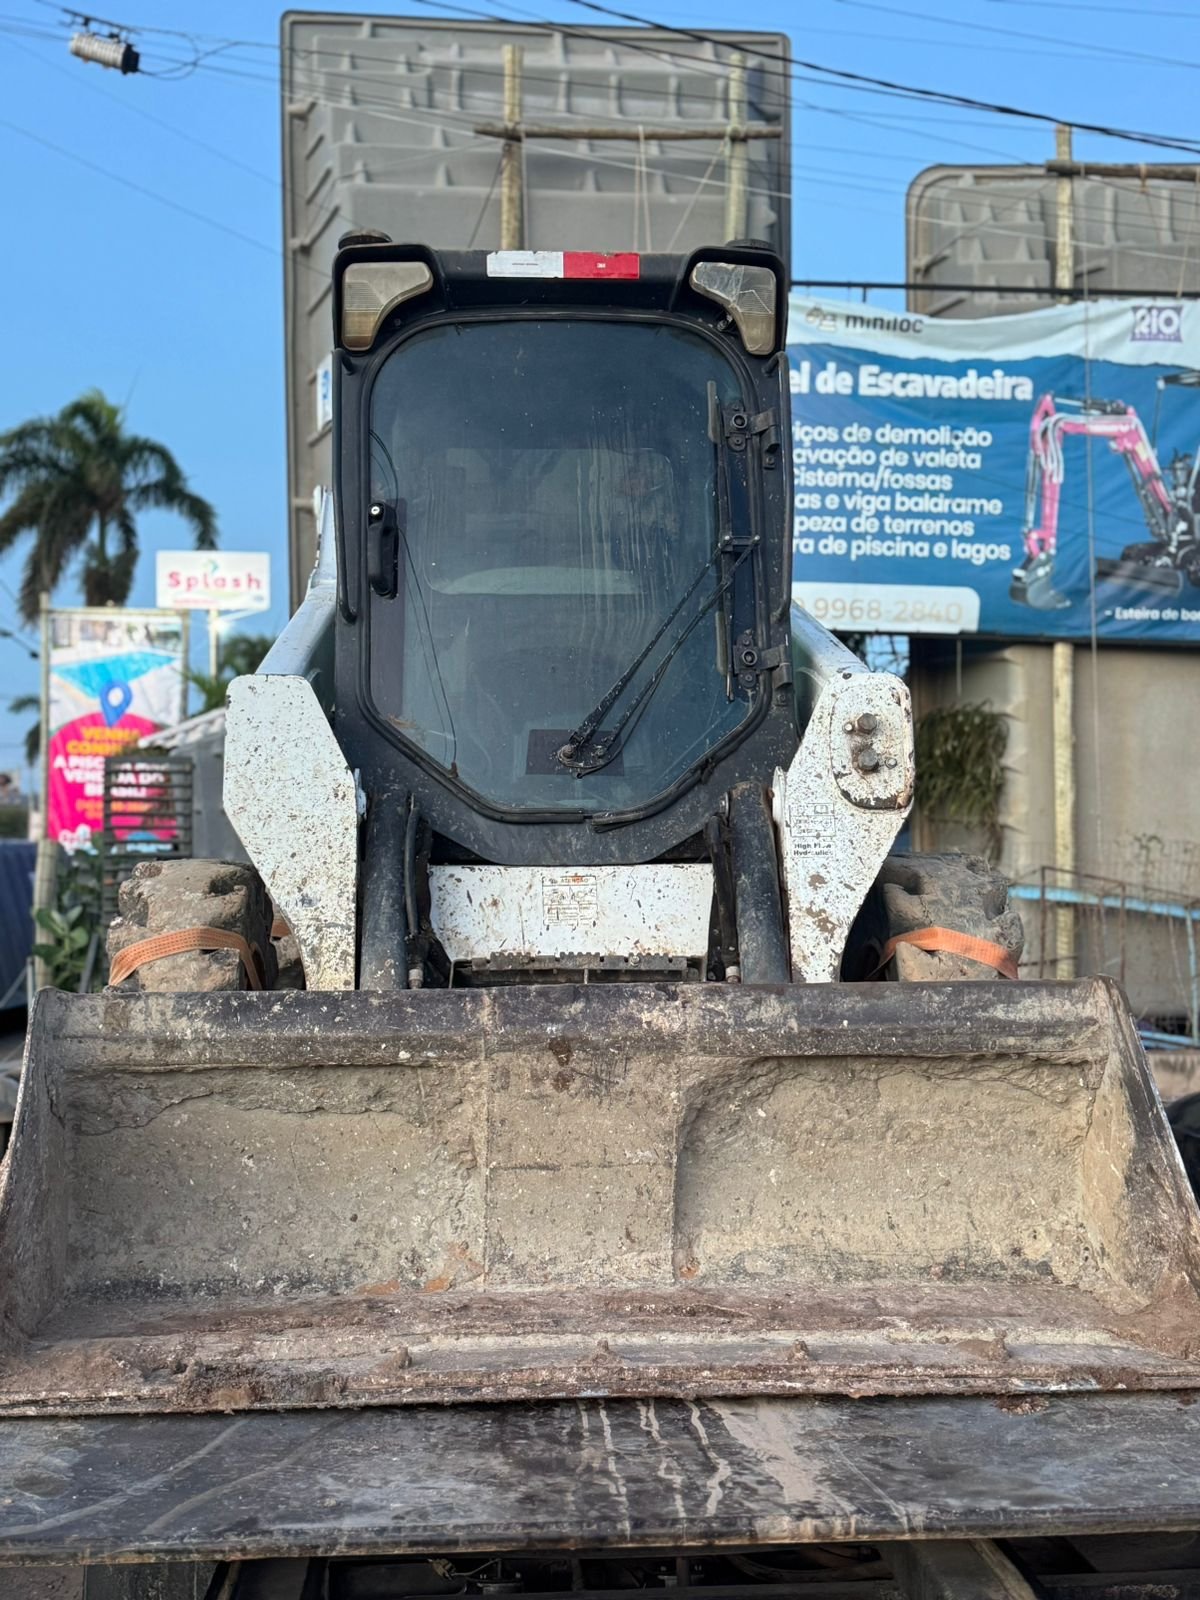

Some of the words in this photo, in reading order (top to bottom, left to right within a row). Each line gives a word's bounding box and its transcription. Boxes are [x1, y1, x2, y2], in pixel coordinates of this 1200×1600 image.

[845, 315, 924, 333] miniloc
[815, 361, 853, 395] de
[858, 364, 1033, 401] Escavadeira
[792, 421, 839, 447] iços
[842, 422, 872, 443] de
[874, 423, 992, 450] demolição
[879, 446, 909, 467] de
[911, 448, 982, 469] valeta
[824, 493, 839, 509] e
[843, 490, 891, 516] viga
[895, 491, 1003, 515] baldrame
[850, 513, 880, 533] de
[883, 515, 975, 537] terrenos
[818, 535, 847, 555] de
[851, 535, 930, 561] piscina
[933, 541, 948, 558] e
[952, 538, 1011, 566] lagos
[168, 571, 261, 592] Splash
[1161, 607, 1180, 621] de
